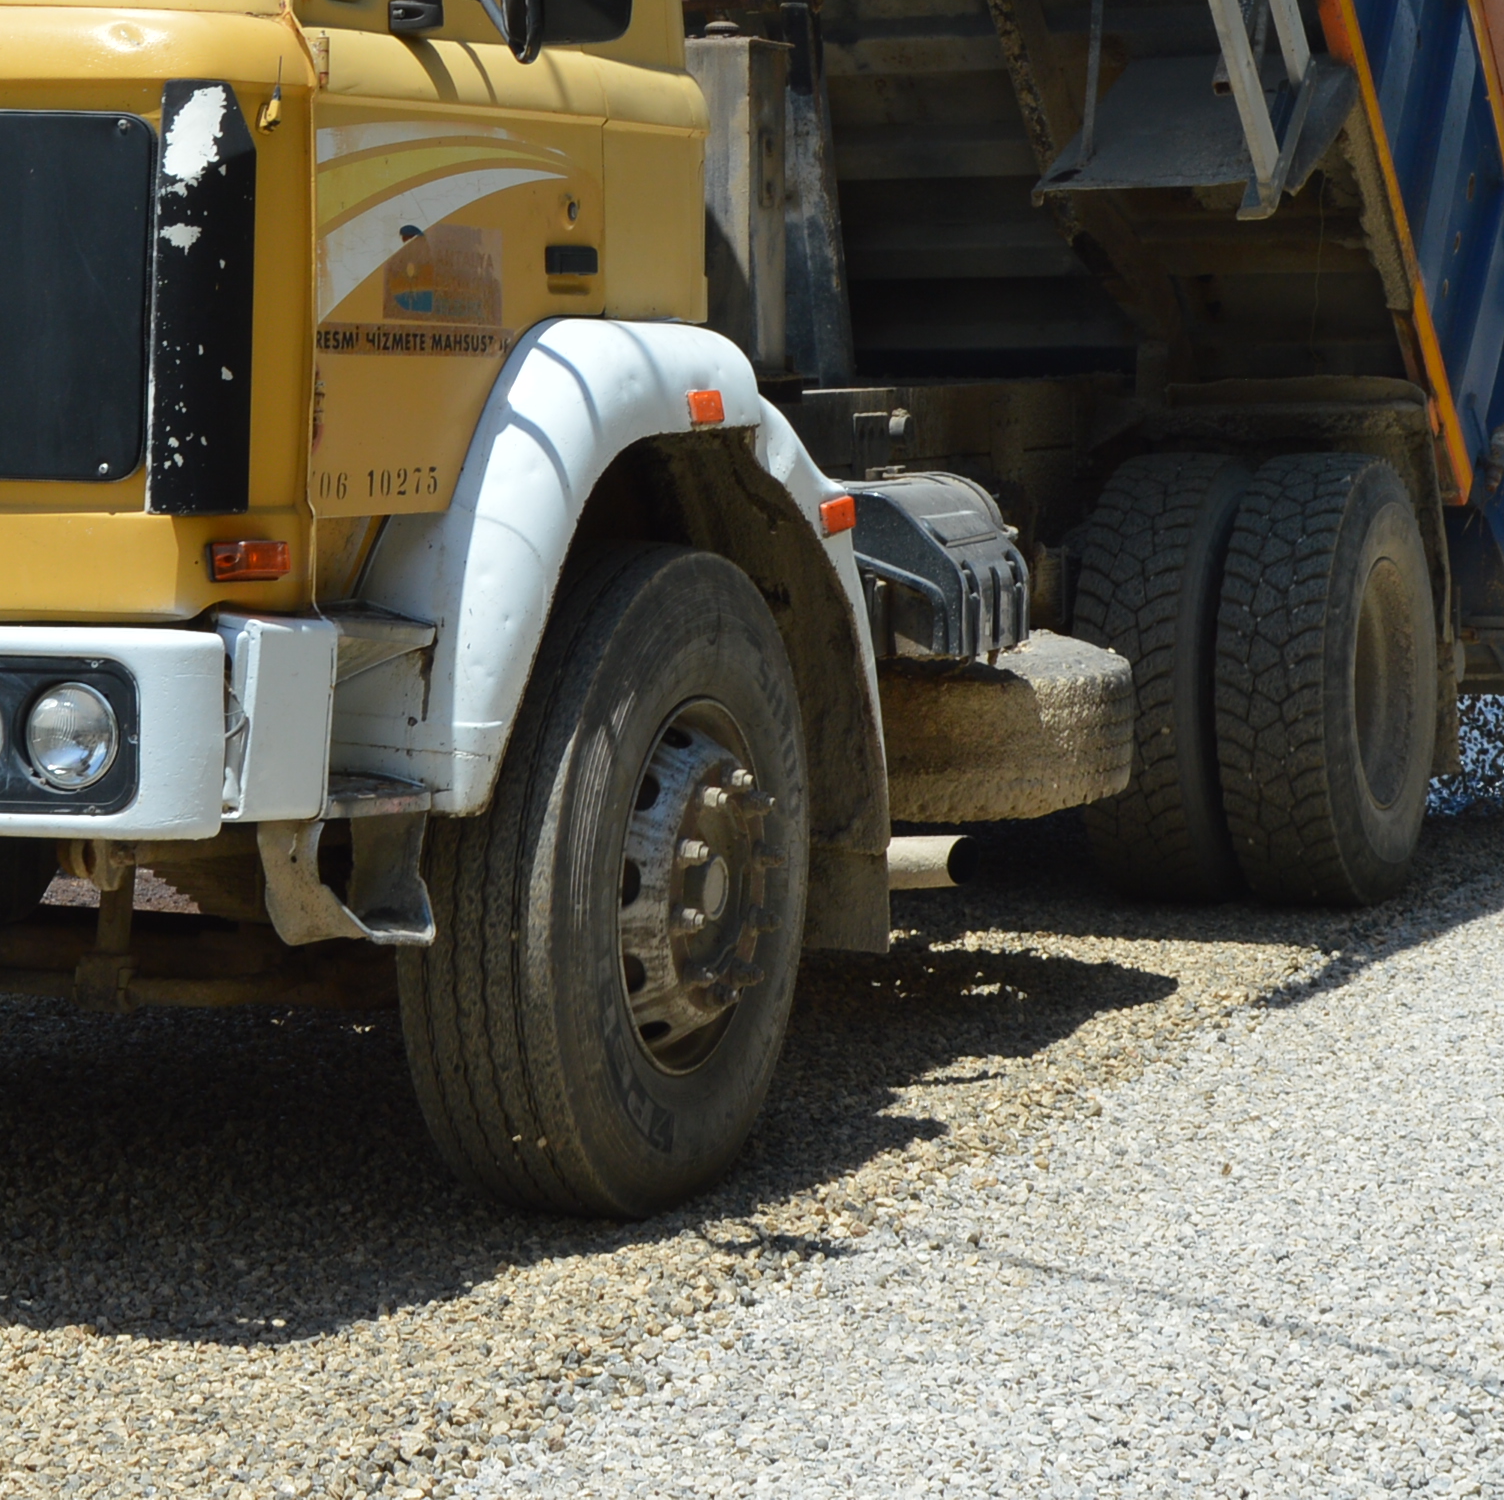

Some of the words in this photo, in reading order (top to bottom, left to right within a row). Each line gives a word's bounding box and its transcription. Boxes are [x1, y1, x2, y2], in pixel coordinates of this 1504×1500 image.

[317, 326, 359, 349] RESMİ
[312, 470, 348, 500] 06
[367, 466, 438, 497] 10275
